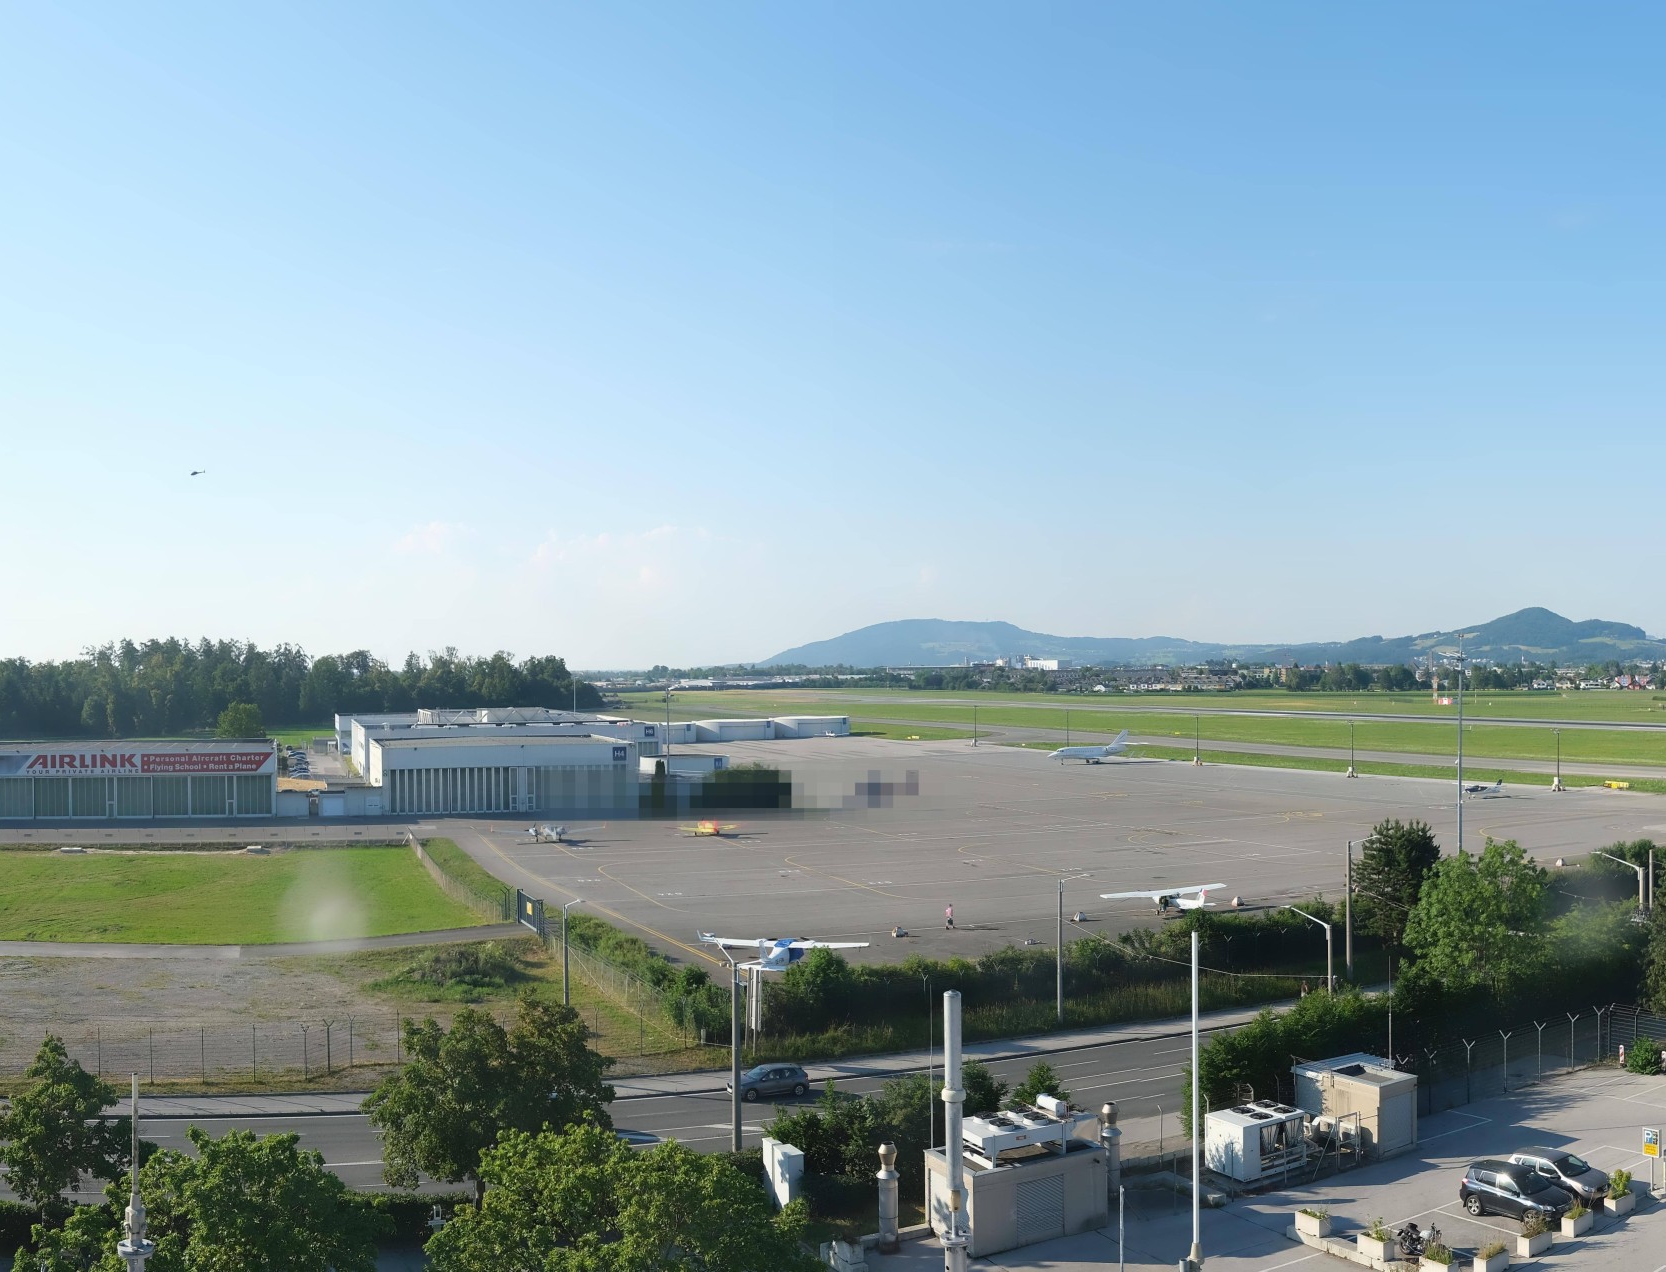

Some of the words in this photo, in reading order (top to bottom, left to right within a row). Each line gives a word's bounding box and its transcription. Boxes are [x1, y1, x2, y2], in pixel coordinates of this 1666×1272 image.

[26, 753, 139, 769] AIRLINK
[192, 754, 227, 762] Aircraft
[149, 763, 174, 771] Flying
